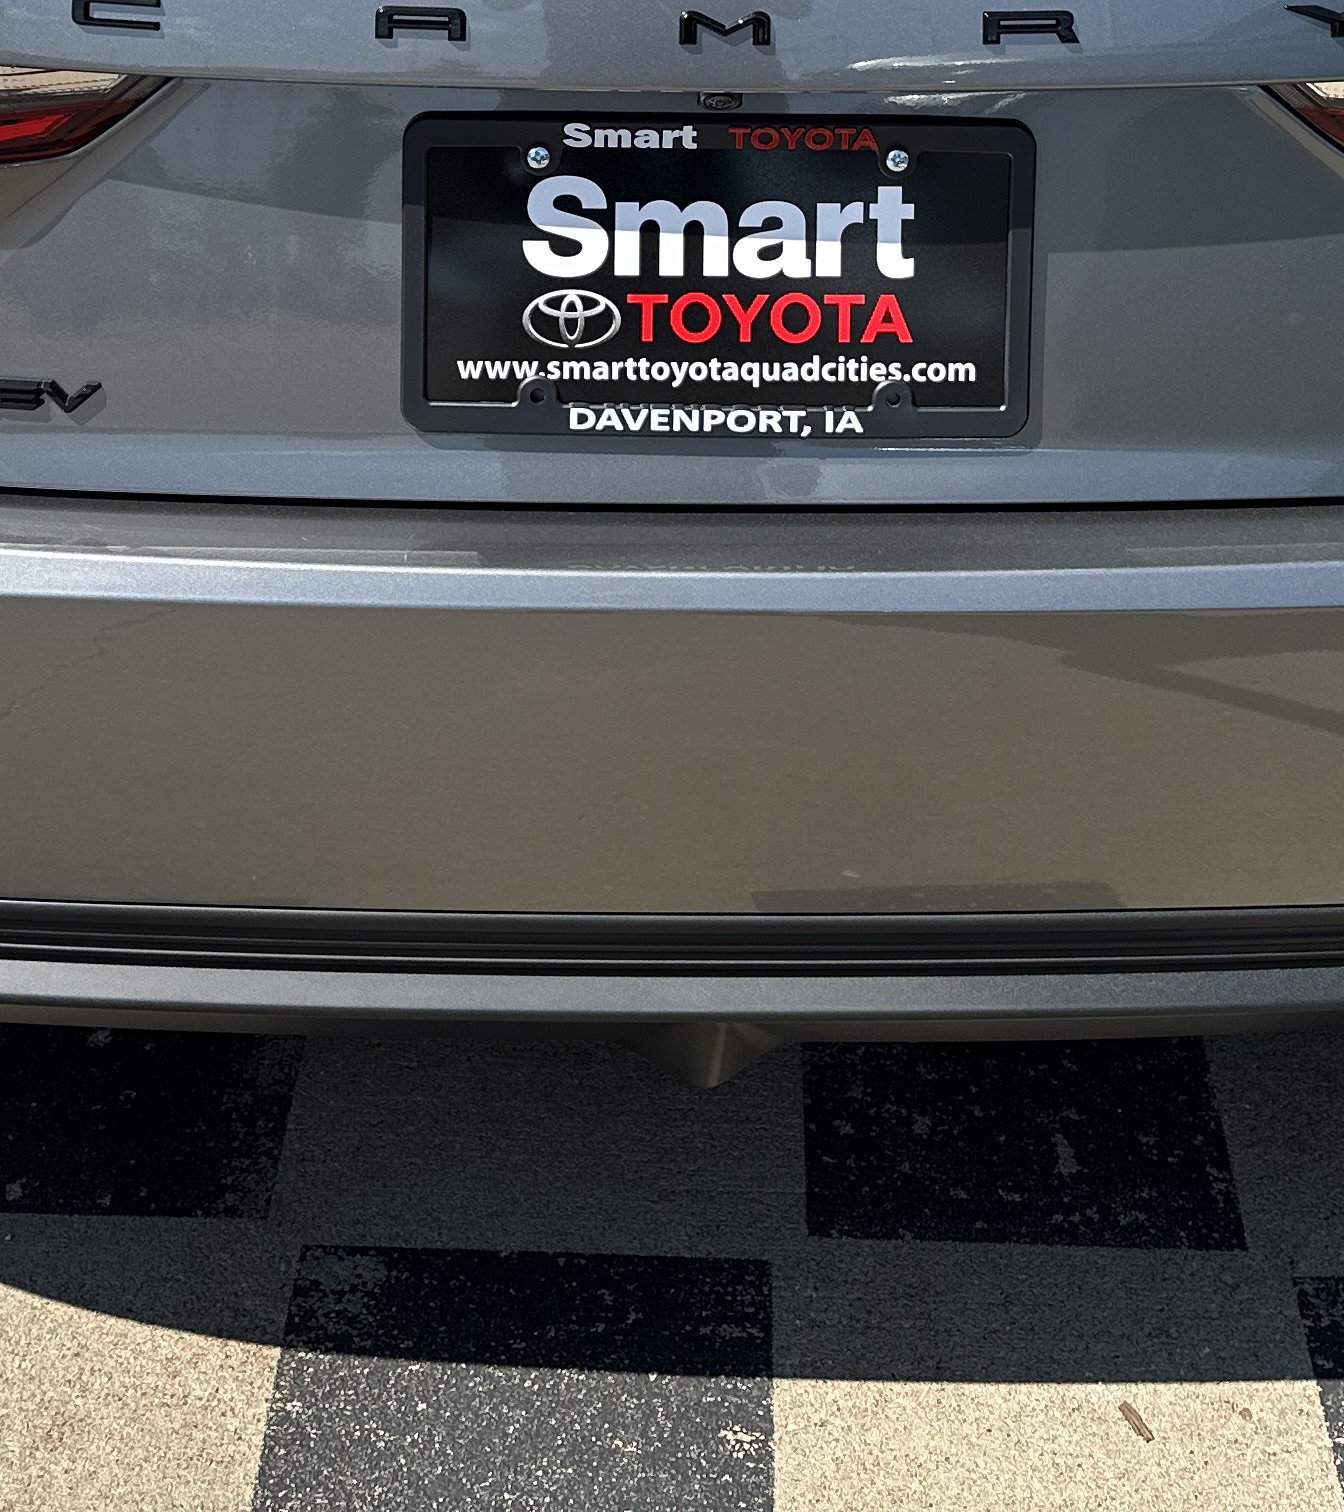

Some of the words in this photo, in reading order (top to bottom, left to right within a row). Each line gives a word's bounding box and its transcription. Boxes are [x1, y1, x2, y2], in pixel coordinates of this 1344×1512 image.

[562, 122, 698, 150] Smart
[728, 125, 880, 152] TOYOTA
[522, 175, 915, 279] Smart
[626, 292, 913, 344] TOYOTA
[457, 354, 976, 387] www.smarttoyotaquadcities.com
[568, 407, 812, 437] DAVENPORT,
[824, 410, 864, 433] IA
